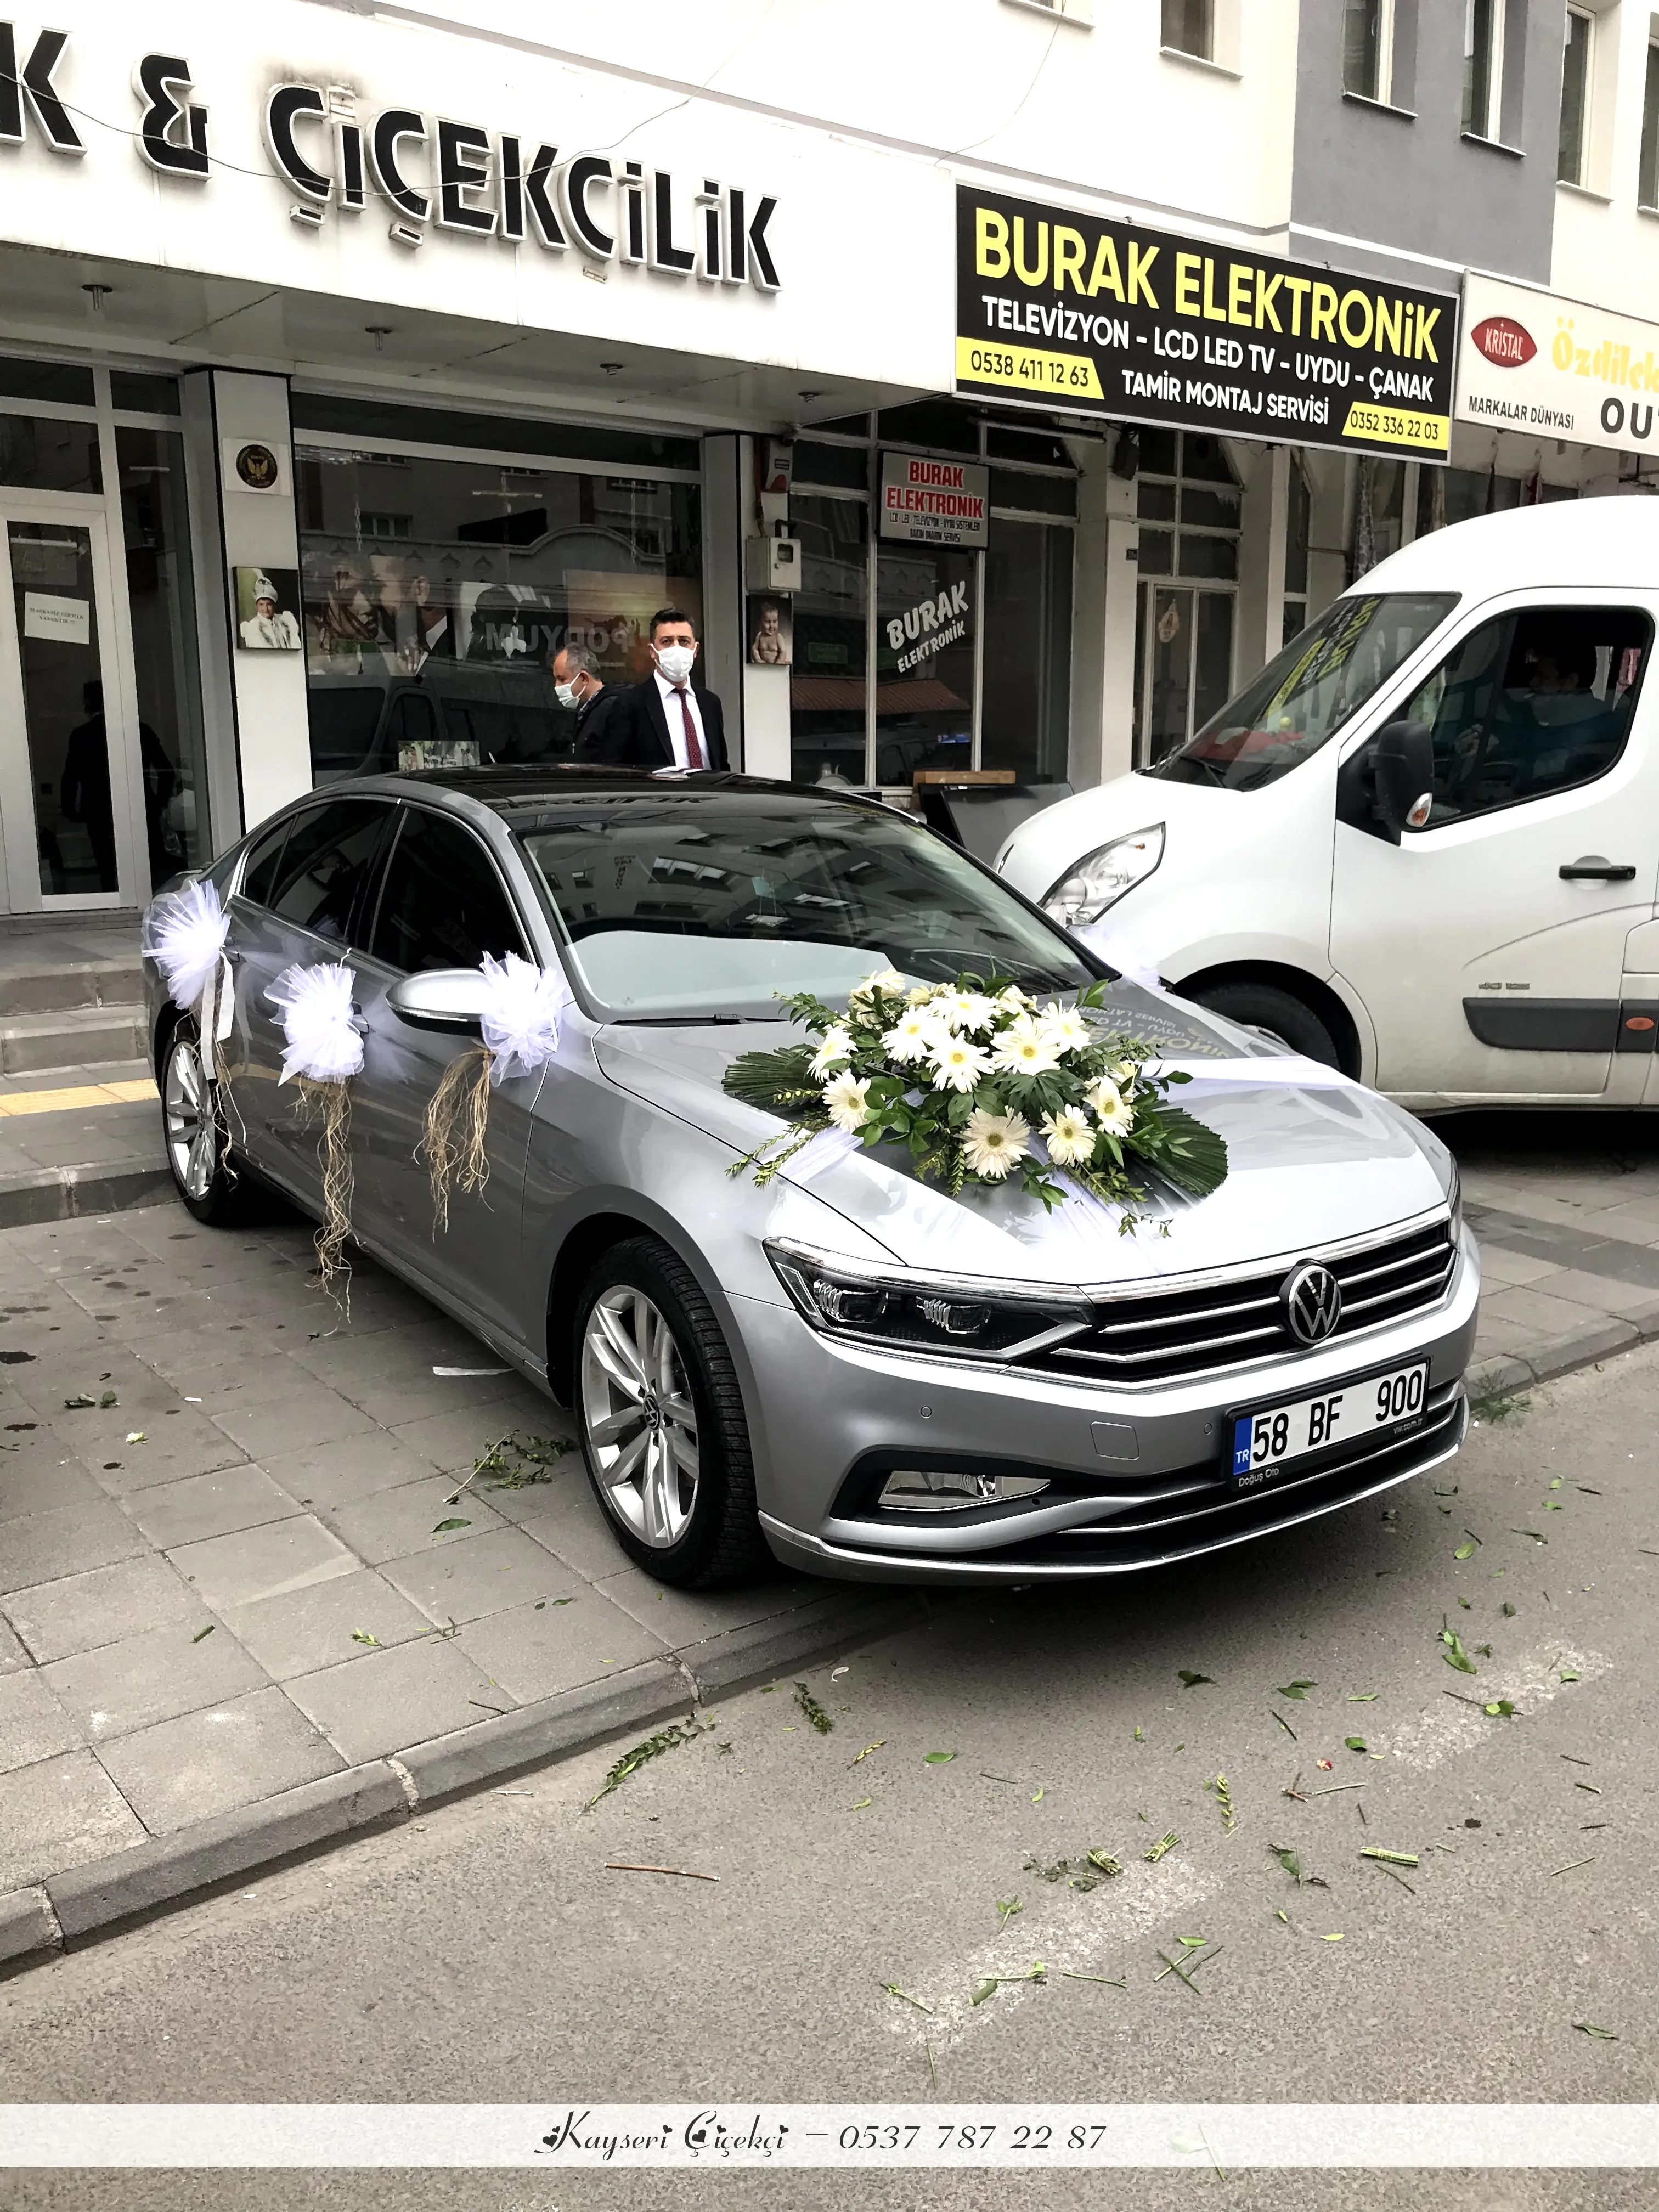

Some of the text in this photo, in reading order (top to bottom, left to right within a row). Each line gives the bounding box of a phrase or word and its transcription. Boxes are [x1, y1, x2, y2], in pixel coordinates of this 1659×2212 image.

[133, 53, 211, 181] &
[975, 207, 1442, 363] BURAK ELEKTRONİK
[971, 350, 1088, 387] 0538 411 12 63
[981, 295, 1129, 349] TELEVİZYON
[1154, 326, 1199, 360] LCD
[1204, 336, 1243, 368] LED
[1248, 343, 1276, 374] TV
[1296, 352, 1350, 387] UYDU
[1369, 366, 1434, 402] ÇANAK
[1121, 369, 1329, 425] TAMİR MONTAJ SERVİSİ
[1469, 396, 1574, 430] MARKALAR DÜNYASI
[1600, 397, 1659, 439] OU
[1350, 410, 1438, 440] 0352 336 22 03
[909, 460, 964, 489] BURAK
[886, 486, 984, 519] ELEKTRONİK
[886, 580, 969, 650] BURAK
[896, 619, 966, 674] ELEKTRONİK
[1252, 1369, 1423, 1463] 58 BF 900
[1235, 1451, 1249, 1464] TR
[1238, 1468, 1279, 1487] Doğuş Oto
